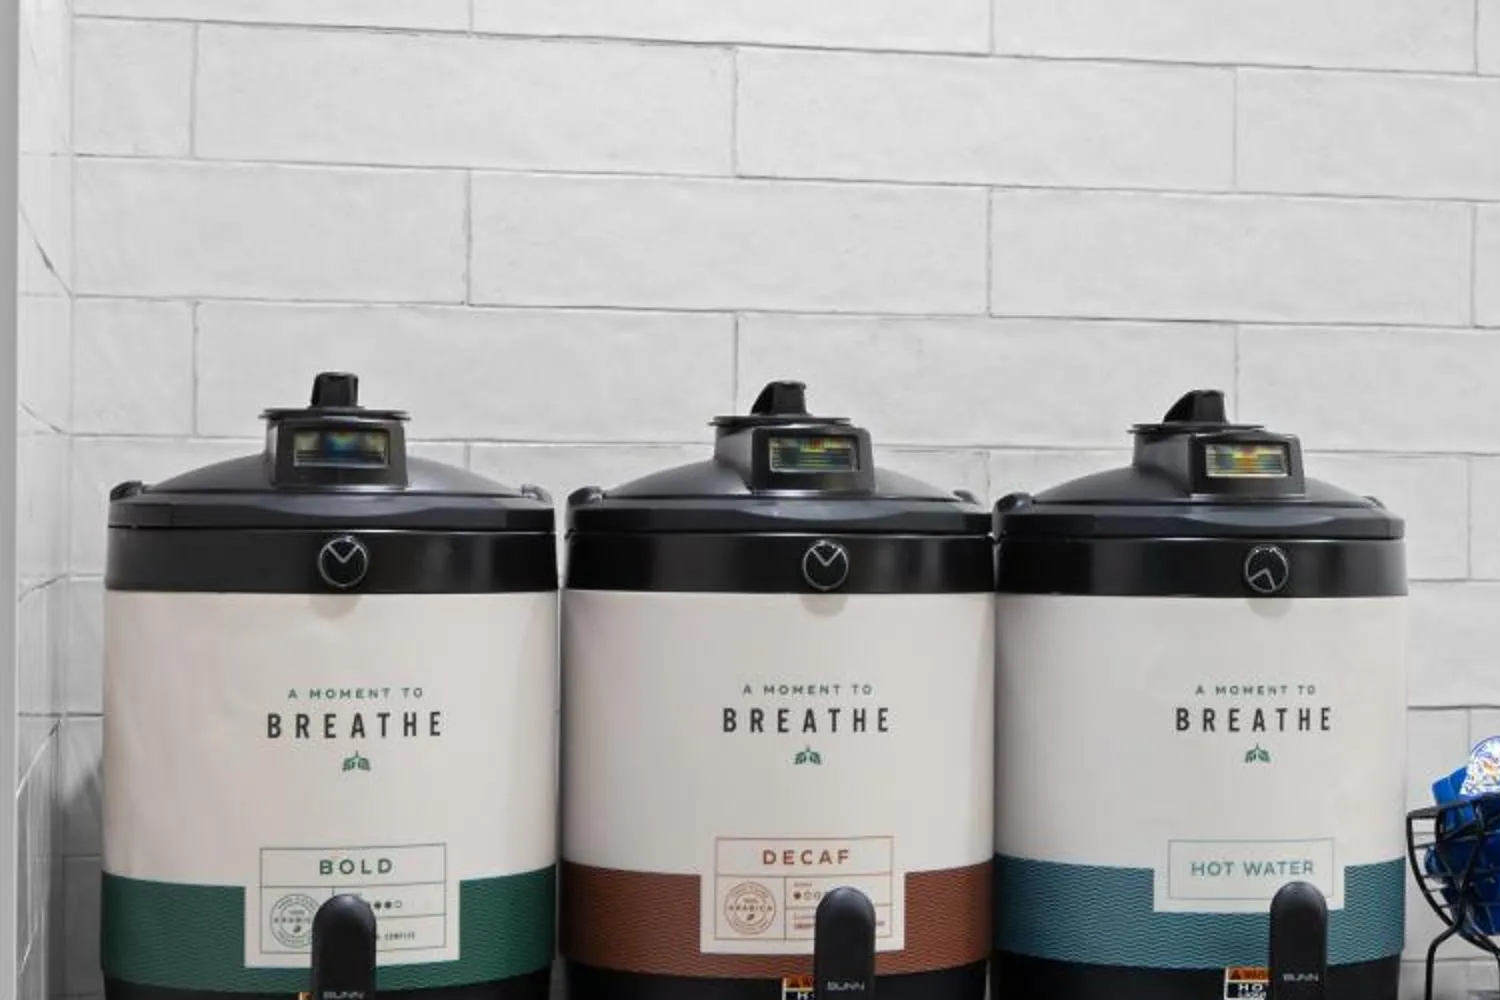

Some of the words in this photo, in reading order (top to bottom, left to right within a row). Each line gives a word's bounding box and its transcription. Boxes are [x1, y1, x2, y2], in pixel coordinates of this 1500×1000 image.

[288, 688, 298, 699] A
[309, 687, 391, 700] MOMENT
[401, 687, 424, 699] TO
[743, 684, 752, 695] A
[763, 684, 841, 696] MOMENT
[852, 684, 873, 695] TO
[1194, 684, 1205, 695] A
[1215, 684, 1288, 696] MOMENT
[1298, 684, 1317, 695] TO
[267, 710, 442, 739] BREATHE
[722, 706, 889, 734] BREATHE
[1175, 706, 1332, 733] BREATHE
[763, 849, 850, 865] DECAF
[319, 858, 393, 875] BOLD
[1190, 861, 1235, 876] HOT
[1244, 860, 1314, 876] WATER
